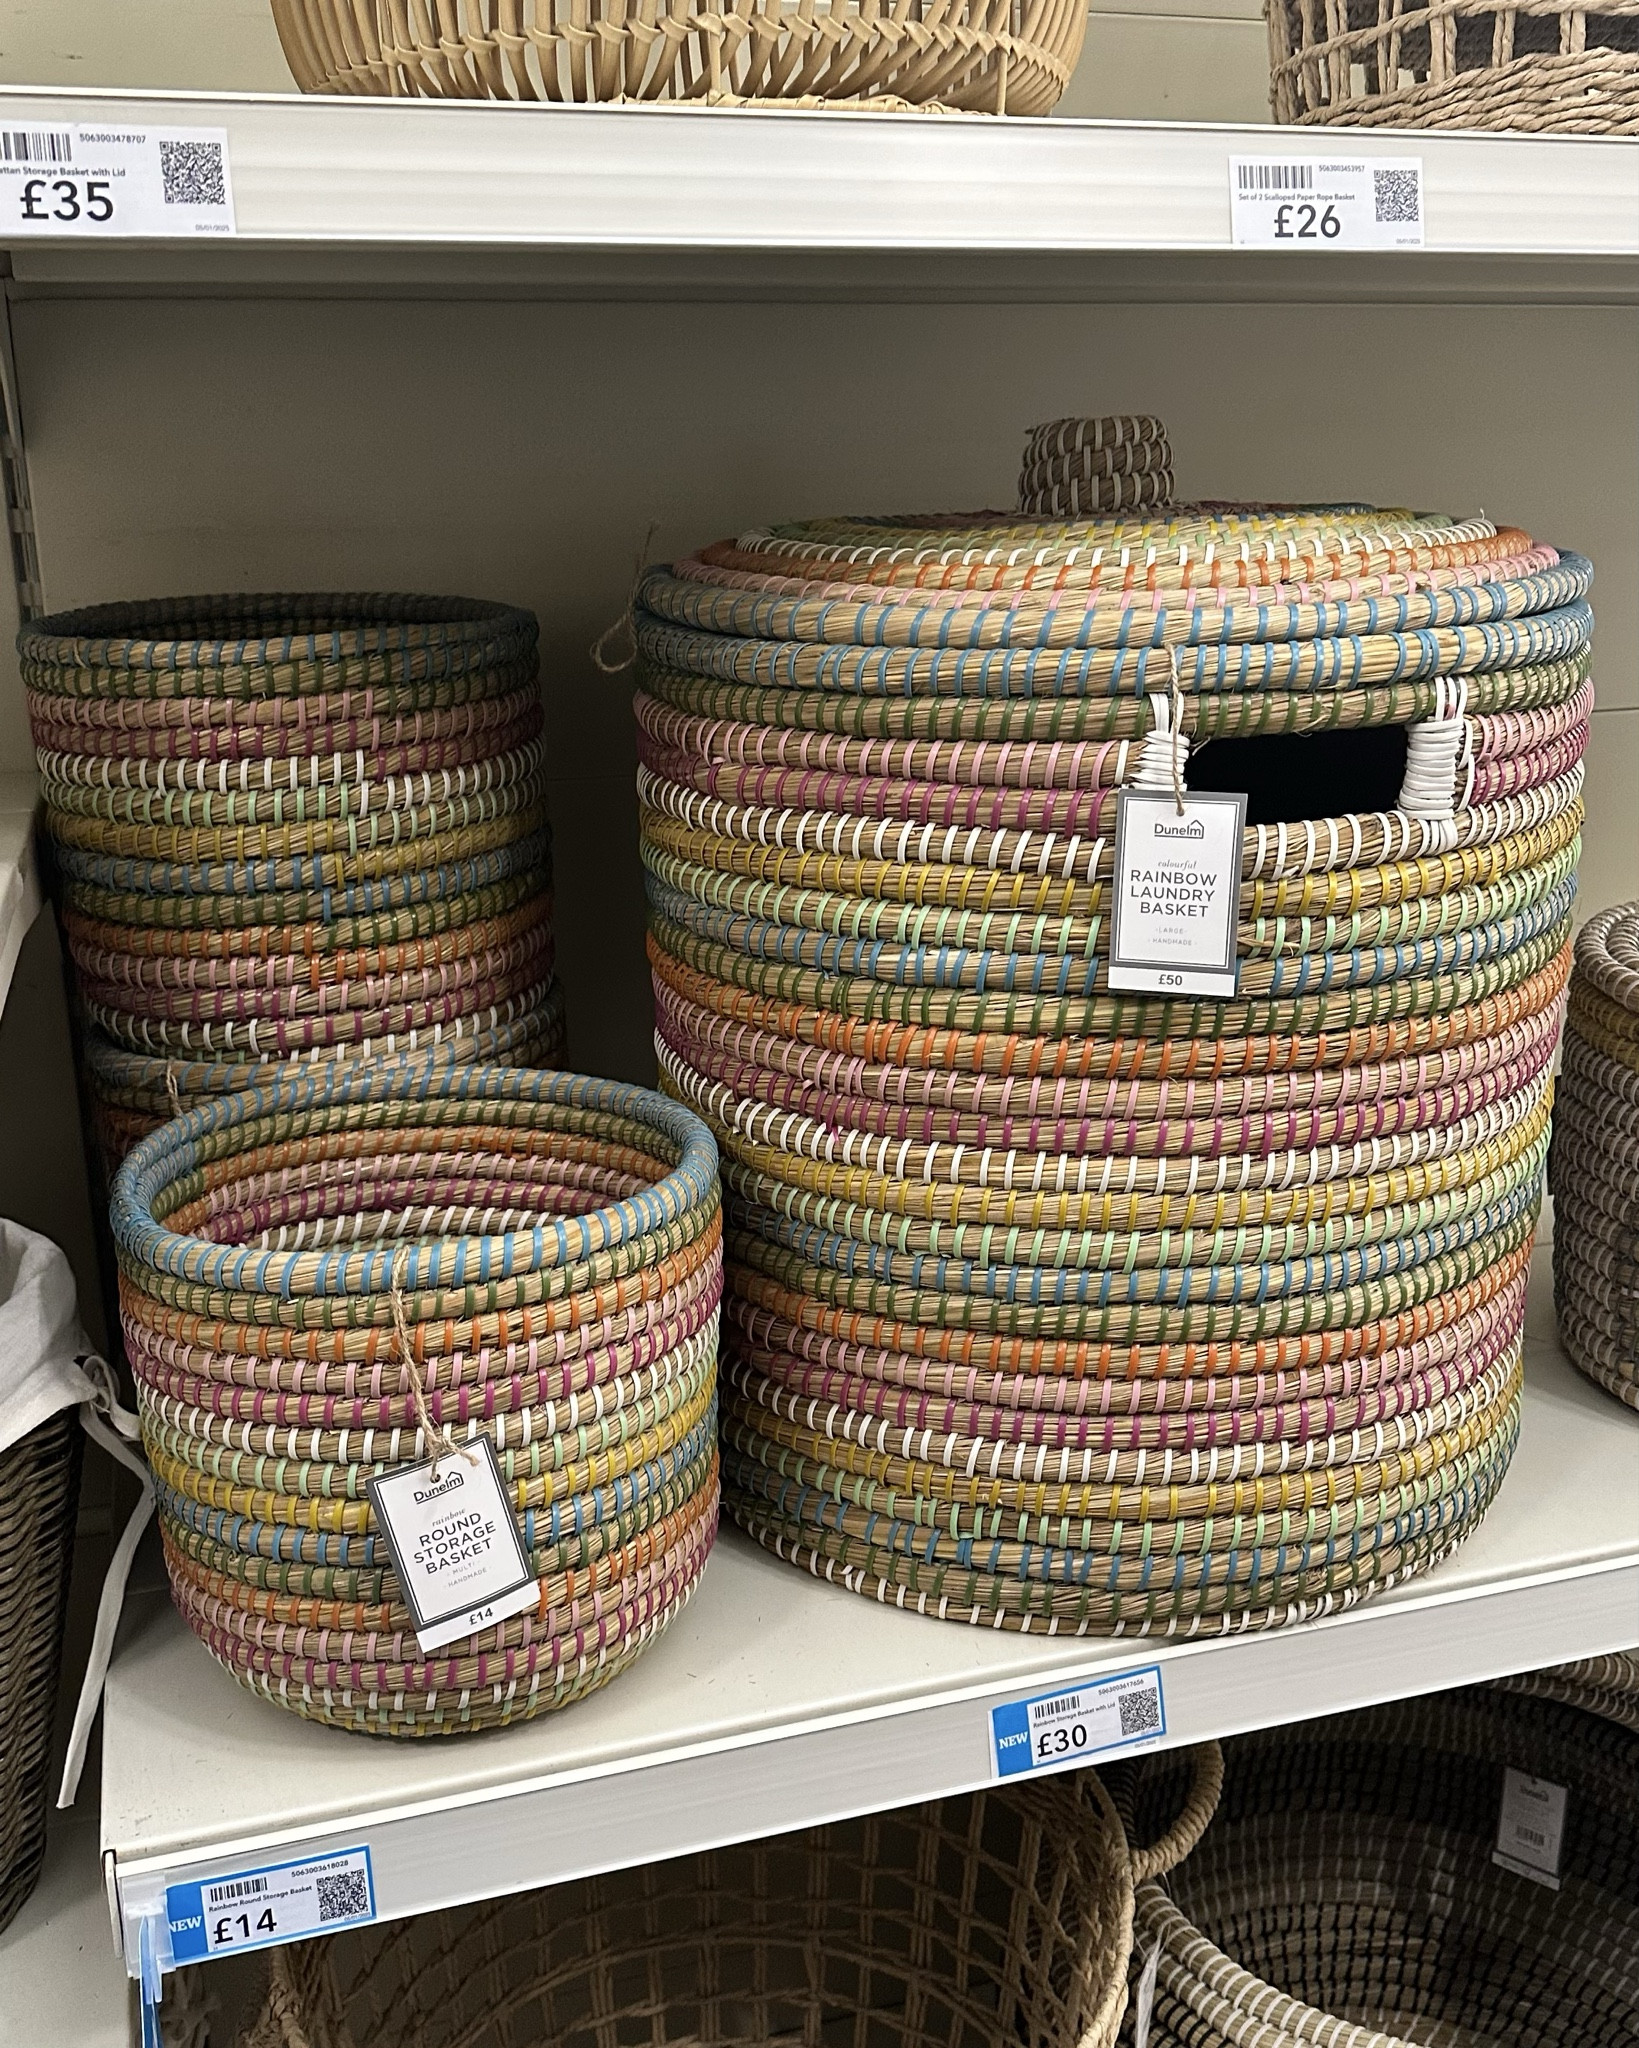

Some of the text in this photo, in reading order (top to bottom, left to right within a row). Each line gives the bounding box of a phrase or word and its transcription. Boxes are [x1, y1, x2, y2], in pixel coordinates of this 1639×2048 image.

[79, 133, 146, 144] 5063003478707
[23, 166, 58, 178] Storage
[60, 167, 89, 177] Basket
[92, 168, 110, 177] with
[112, 168, 126, 177] Lid
[20, 179, 114, 221] £35
[1239, 193, 1249, 201] Set
[1250, 193, 1257, 201] of
[1258, 193, 1263, 201] 2
[1264, 193, 1295, 202] Scalloped
[1297, 194, 1316, 202] Paper
[1317, 194, 1333, 202] Rope
[1274, 204, 1341, 239] £26
[1154, 822, 1203, 837] Dunelm
[1158, 859, 1197, 871] colourful
[1130, 870, 1217, 886] RAINBOW
[1130, 886, 1215, 902] LAUNDRY
[1140, 902, 1208, 917] BASKET
[1158, 974, 1183, 986] £50
[413, 1474, 463, 1502] Dunelm
[432, 1508, 465, 1527] rainbow
[419, 1512, 481, 1547] ROUND
[414, 1521, 496, 1564] STORAGE
[425, 1538, 492, 1574] BASKET
[469, 1608, 493, 1625] £14
[1033, 1718, 1056, 1728] Rainbow
[1056, 1712, 1077, 1722] Storage
[1077, 1707, 1095, 1716] Basket
[1095, 1704, 1106, 1712] with
[999, 1731, 1028, 1749] NEW
[1037, 1724, 1087, 1758] £30
[291, 1860, 348, 1877] 5063003618028
[209, 1885, 312, 1912] Rainbow Round Storage Basket
[168, 1916, 202, 1933] NEW
[213, 1908, 277, 1944] £14
